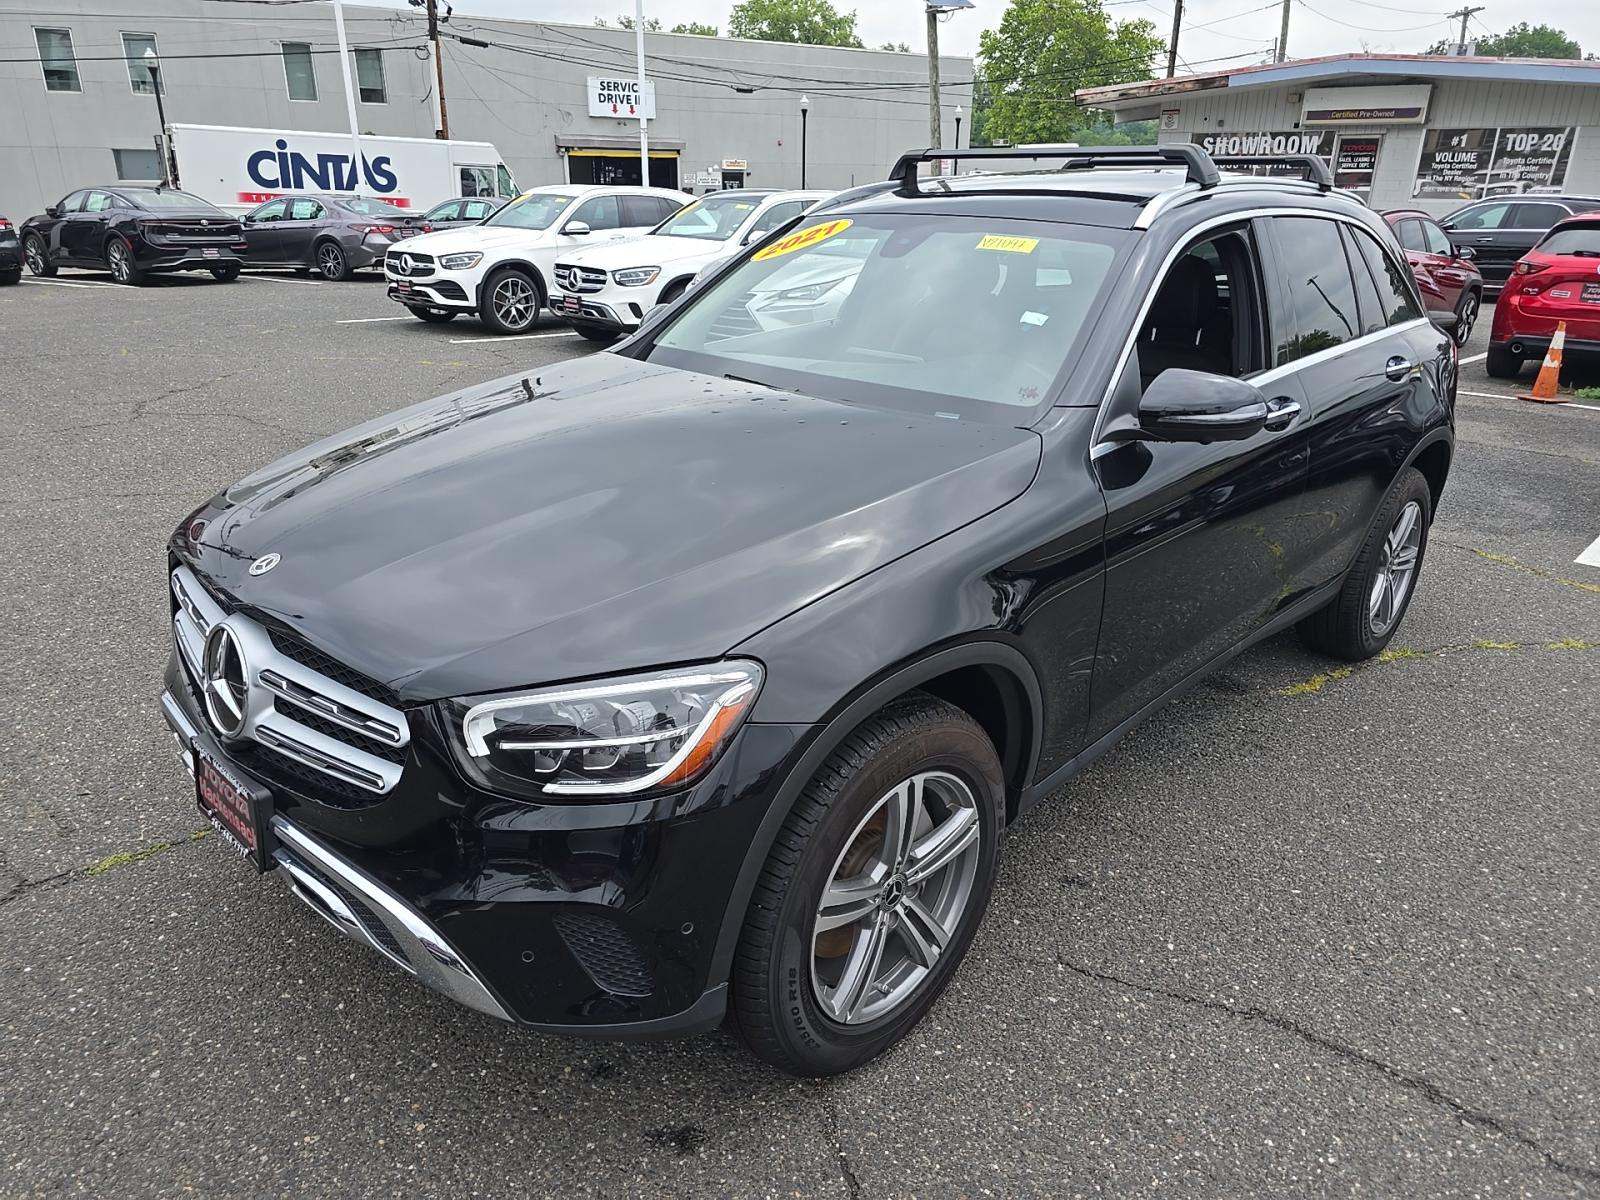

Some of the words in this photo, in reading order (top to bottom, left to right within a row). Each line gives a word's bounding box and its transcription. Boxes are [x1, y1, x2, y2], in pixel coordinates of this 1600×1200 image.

[600, 81, 638, 92] SERVIC
[599, 93, 632, 105] DRIVE
[1331, 111, 1358, 119] Certified
[1359, 110, 1395, 118] Pre-Owned
[1202, 135, 1320, 155] SHOWROOM
[1451, 133, 1468, 148] #1
[1506, 134, 1536, 151] TOP
[1540, 134, 1565, 151] 20
[1435, 152, 1478, 163] VOLUME
[1503, 157, 1525, 166] Toyota
[1431, 163, 1450, 171] Toyota
[760, 222, 841, 258] 2021
